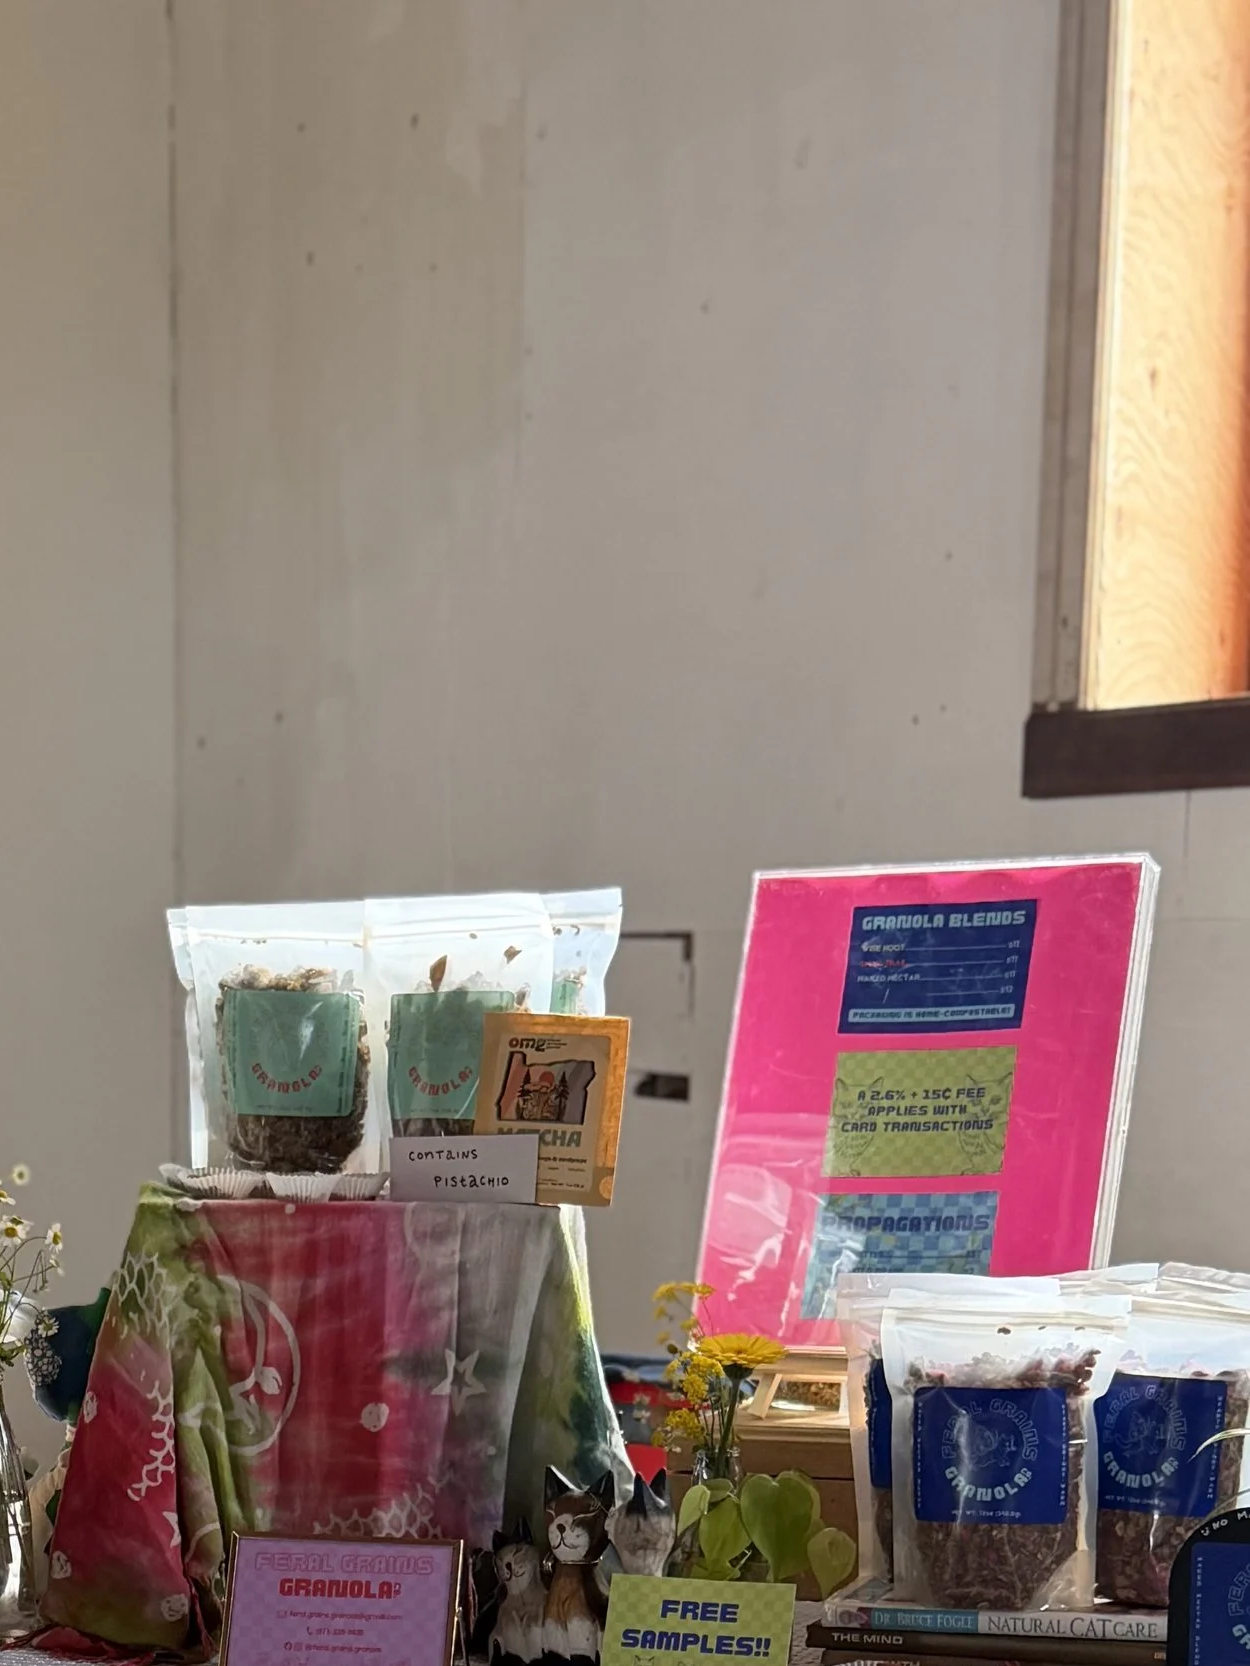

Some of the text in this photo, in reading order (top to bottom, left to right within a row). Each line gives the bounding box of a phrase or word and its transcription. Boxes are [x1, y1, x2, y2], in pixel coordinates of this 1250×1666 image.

[862, 910, 1026, 931] GRANOLA BLENDS
[857, 1090, 866, 1101] A
[870, 1090, 906, 1101] 2.6%
[956, 1087, 986, 1099] FEE
[867, 1104, 968, 1117] APPLIES WITH
[841, 1117, 994, 1133] CARD TRANSACTIONS
[821, 1213, 991, 1233] PROPAGATIONS
[1103, 1451, 1174, 1489] GRANOLA
[944, 1466, 1028, 1502] GRANOLA
[1212, 1518, 1229, 1530] NO
[255, 1551, 434, 1576] FERAL GRAINS
[278, 1577, 394, 1600] GRANOLA
[660, 1599, 740, 1623] FREE
[897, 1613, 934, 1628] BRUCE
[937, 1614, 975, 1629] FOGLE
[987, 1615, 1158, 1639] NATURAL CAT CARE
[620, 1628, 771, 1658] SAMPLES!!
[832, 1632, 903, 1645] THE MIND
